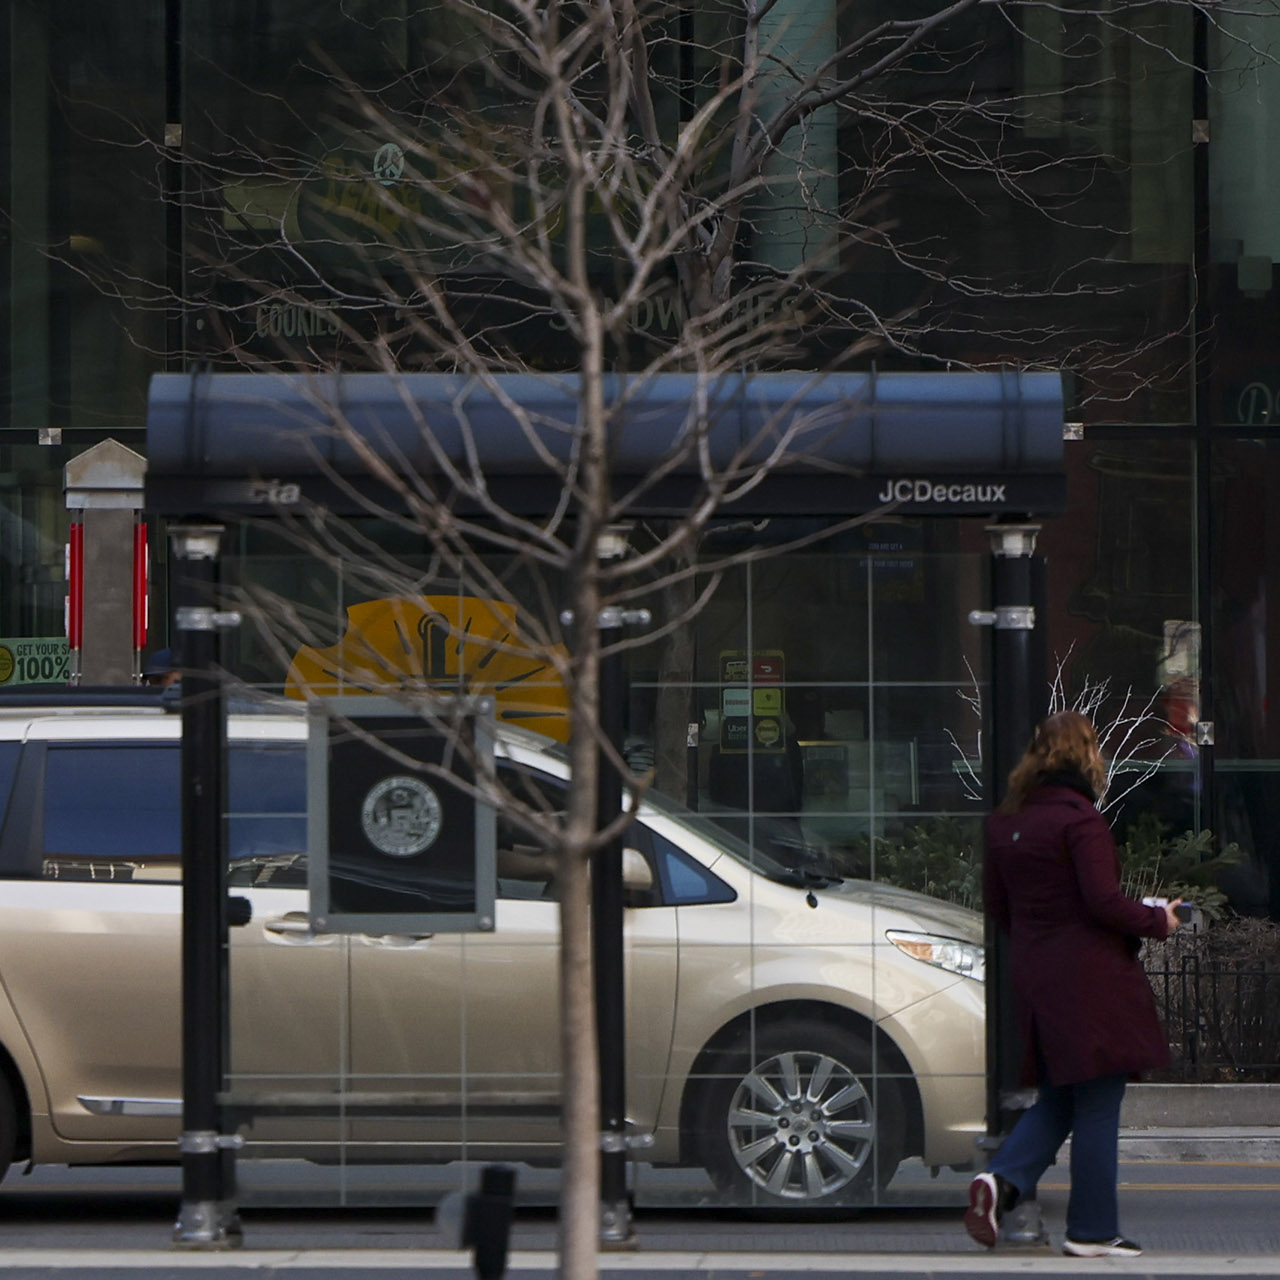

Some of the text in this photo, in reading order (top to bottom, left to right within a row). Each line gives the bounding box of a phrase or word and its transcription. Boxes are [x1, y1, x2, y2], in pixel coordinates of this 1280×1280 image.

[879, 479, 1006, 503] JCDecaux
[17, 644, 32, 656] GET
[35, 644, 59, 656] YOUR
[17, 656, 70, 680] 100%
